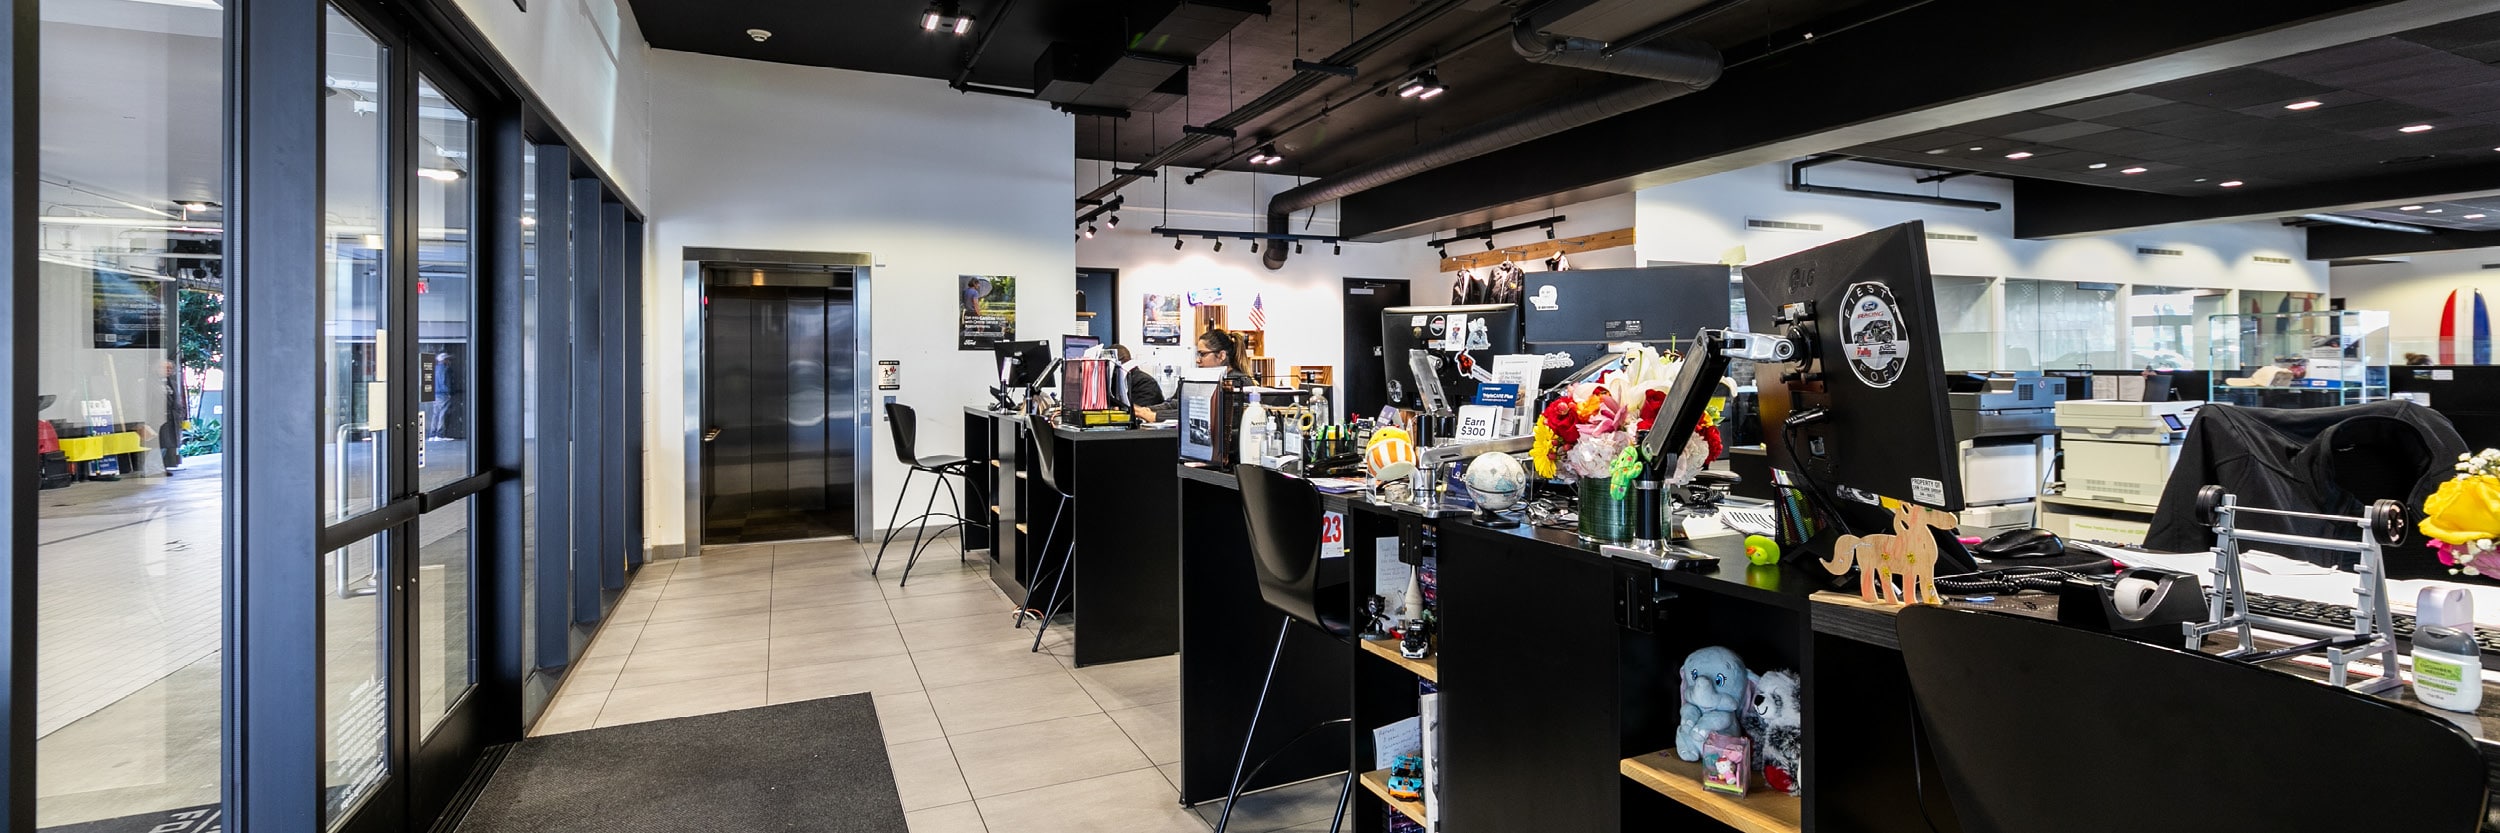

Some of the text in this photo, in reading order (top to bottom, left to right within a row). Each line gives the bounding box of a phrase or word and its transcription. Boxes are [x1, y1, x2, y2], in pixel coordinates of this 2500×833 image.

[1845, 285, 1898, 318] FIESTA
[1858, 311, 1884, 319] RACING
[92, 417, 107, 426] We
[1465, 417, 1486, 426] Earn
[1461, 426, 1486, 436] $300
[1911, 479, 1933, 487] PROPERTY
[1322, 515, 1342, 542] 23
